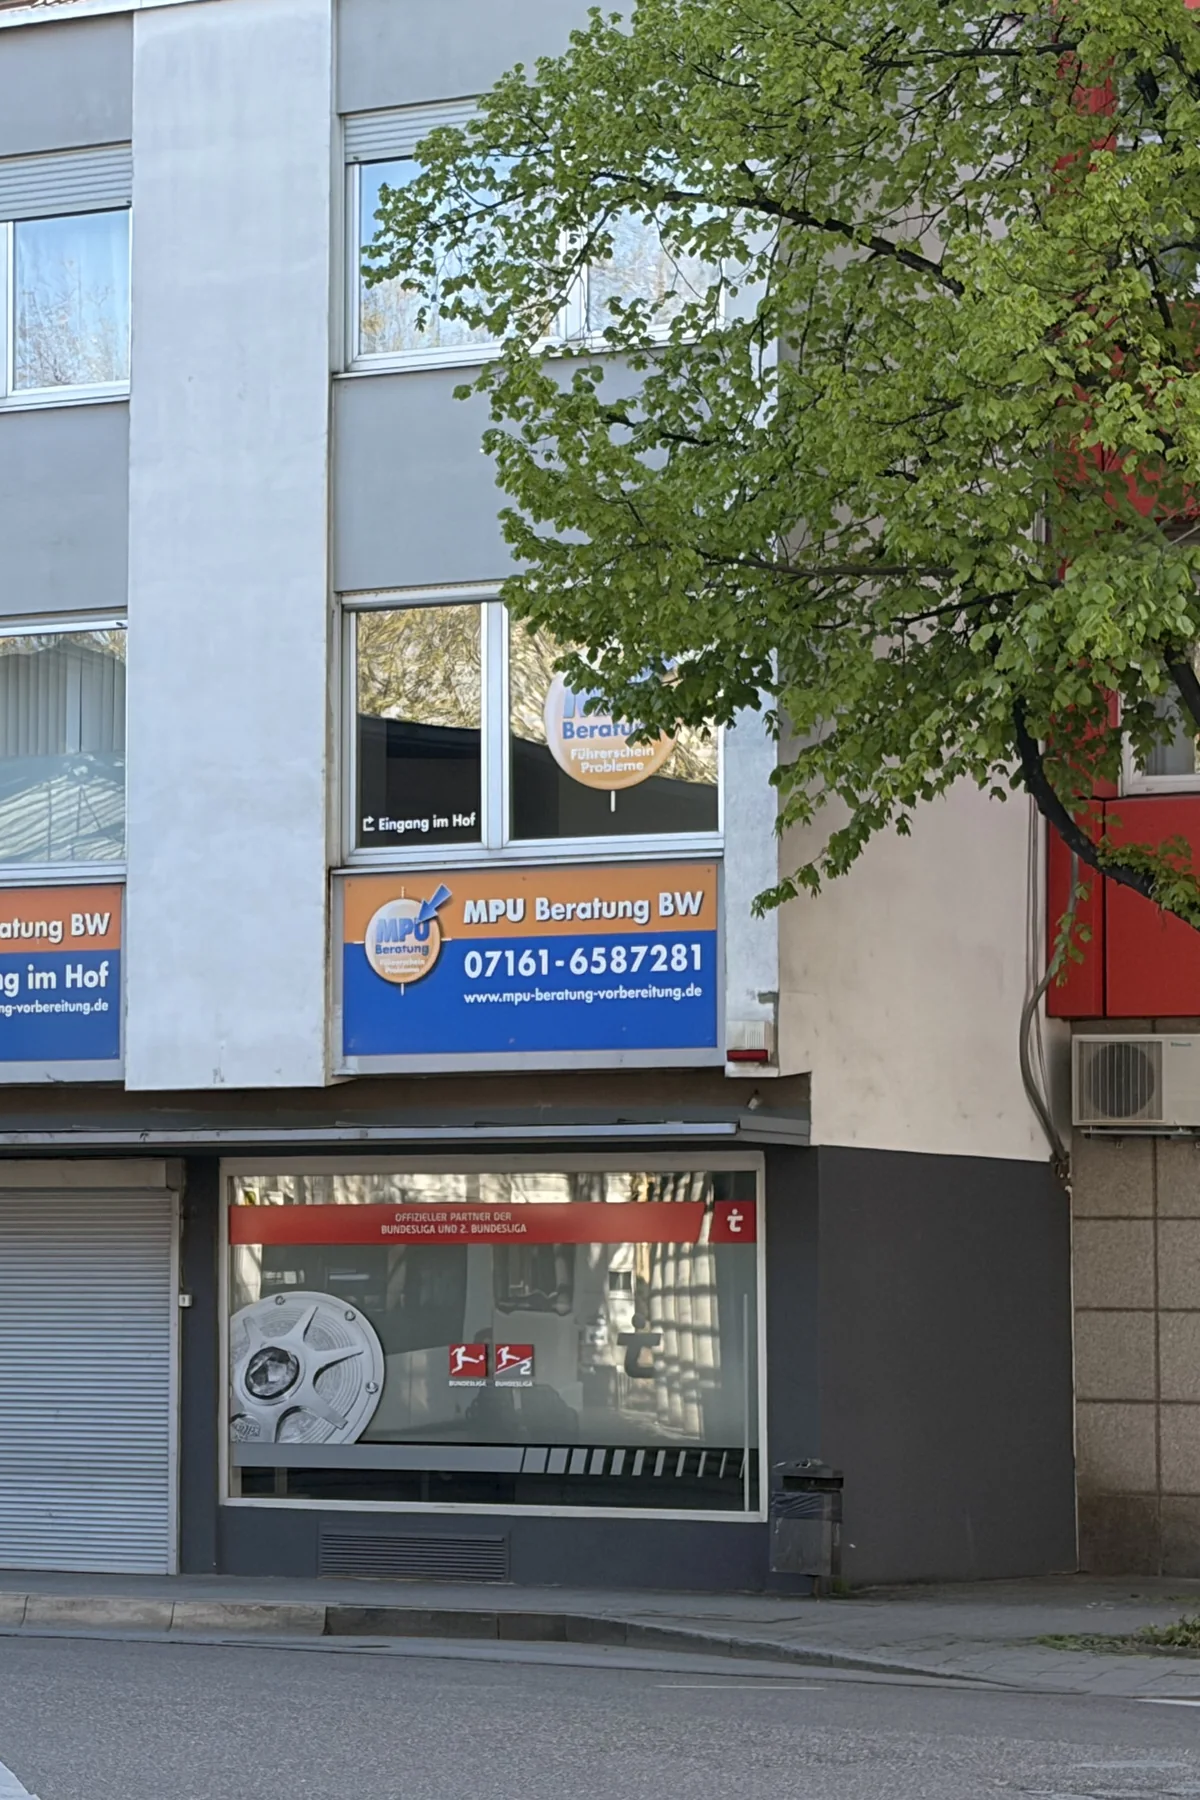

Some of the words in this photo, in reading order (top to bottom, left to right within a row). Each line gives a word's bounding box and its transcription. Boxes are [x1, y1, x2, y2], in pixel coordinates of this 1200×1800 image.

[563, 721, 642, 739] Beratu
[571, 747, 654, 760] Führerschein
[581, 759, 644, 773] Probleme
[379, 817, 429, 833] Eingang
[433, 814, 449, 828] im
[452, 812, 476, 827] Hof
[463, 898, 524, 924] MPU
[536, 897, 650, 925] Beratung
[658, 891, 704, 917] BW
[70, 912, 111, 936] BW
[376, 918, 430, 943] MPU
[375, 944, 429, 956] Beratung
[464, 944, 702, 979] 07161-6587281
[27, 963, 57, 989] im
[65, 961, 109, 988] Hof
[463, 984, 702, 1005] www.mpu-beratung-vorbereitung.de
[395, 1212, 447, 1222] OFFIZIELLER
[451, 1212, 491, 1222] PARTNER
[494, 1211, 512, 1221] DER
[381, 1224, 435, 1234] BUNDESLIGA
[438, 1224, 457, 1234] UND
[471, 1223, 527, 1234] BUNDESLIGA
